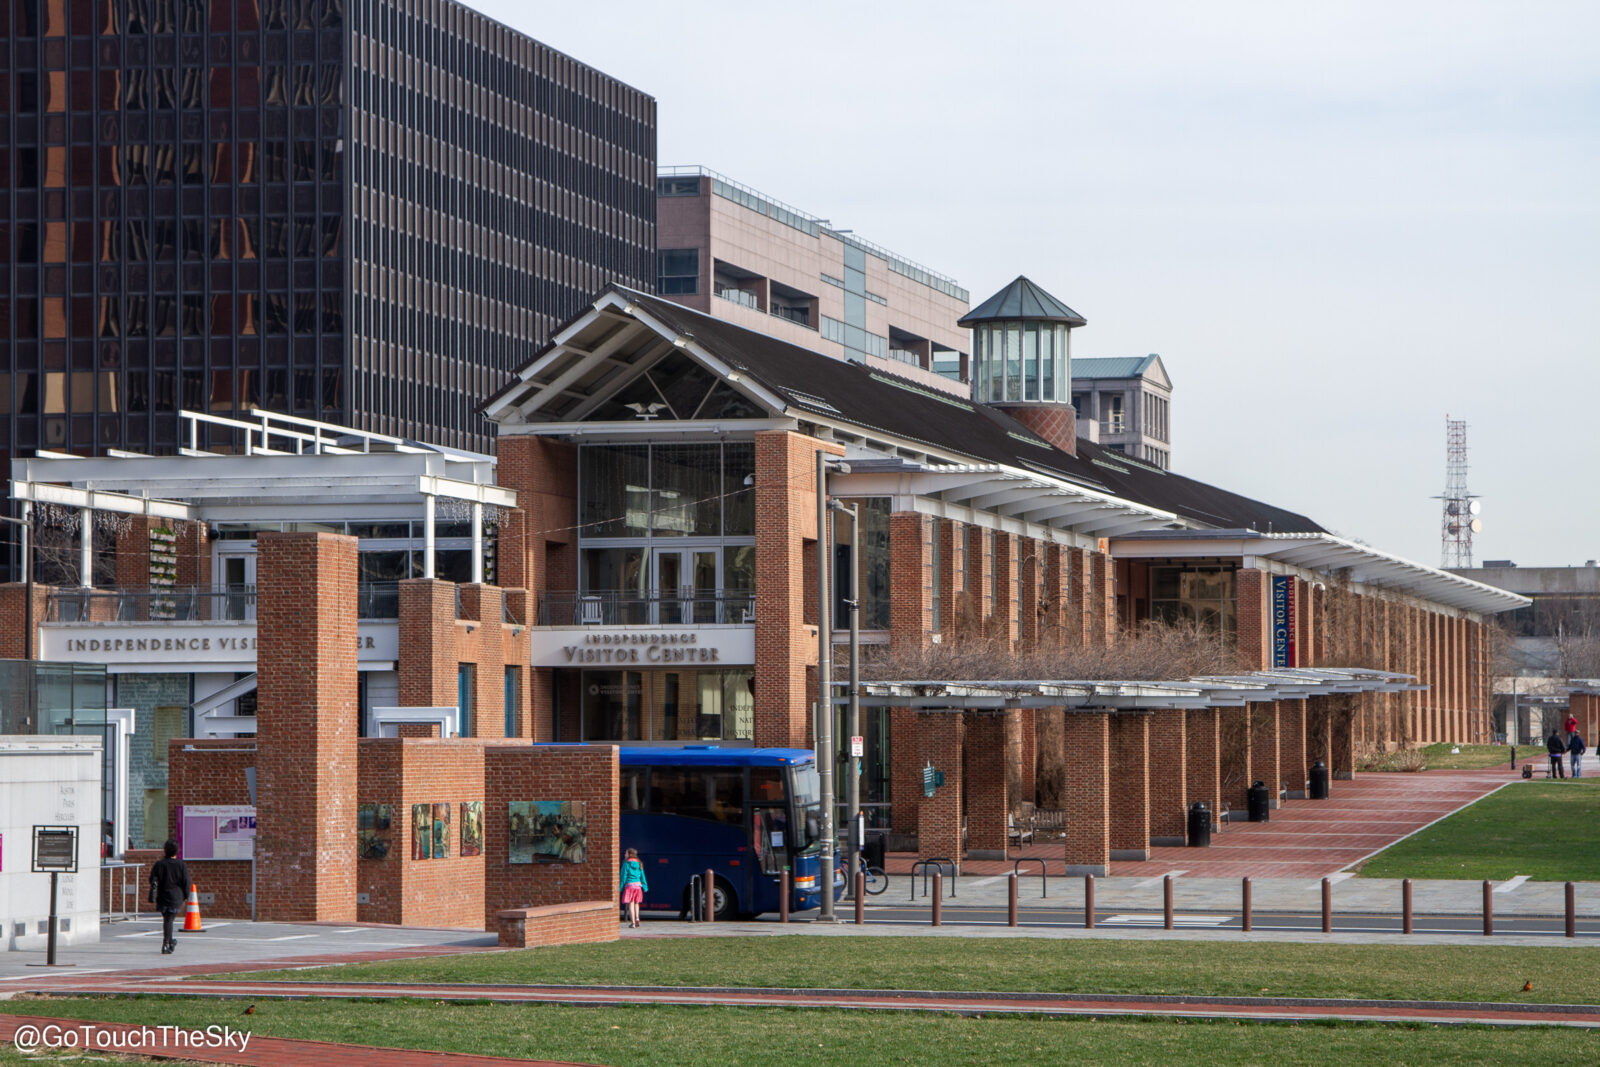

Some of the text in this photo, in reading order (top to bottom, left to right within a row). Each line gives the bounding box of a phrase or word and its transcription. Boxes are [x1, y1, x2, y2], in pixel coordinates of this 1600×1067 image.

[1276, 581, 1287, 669] VISITOR CENTE
[67, 637, 258, 651] INDEPENDENCE VISI
[585, 633, 697, 645] INDEPENDENCE
[563, 645, 720, 663] VISITOR CENTER
